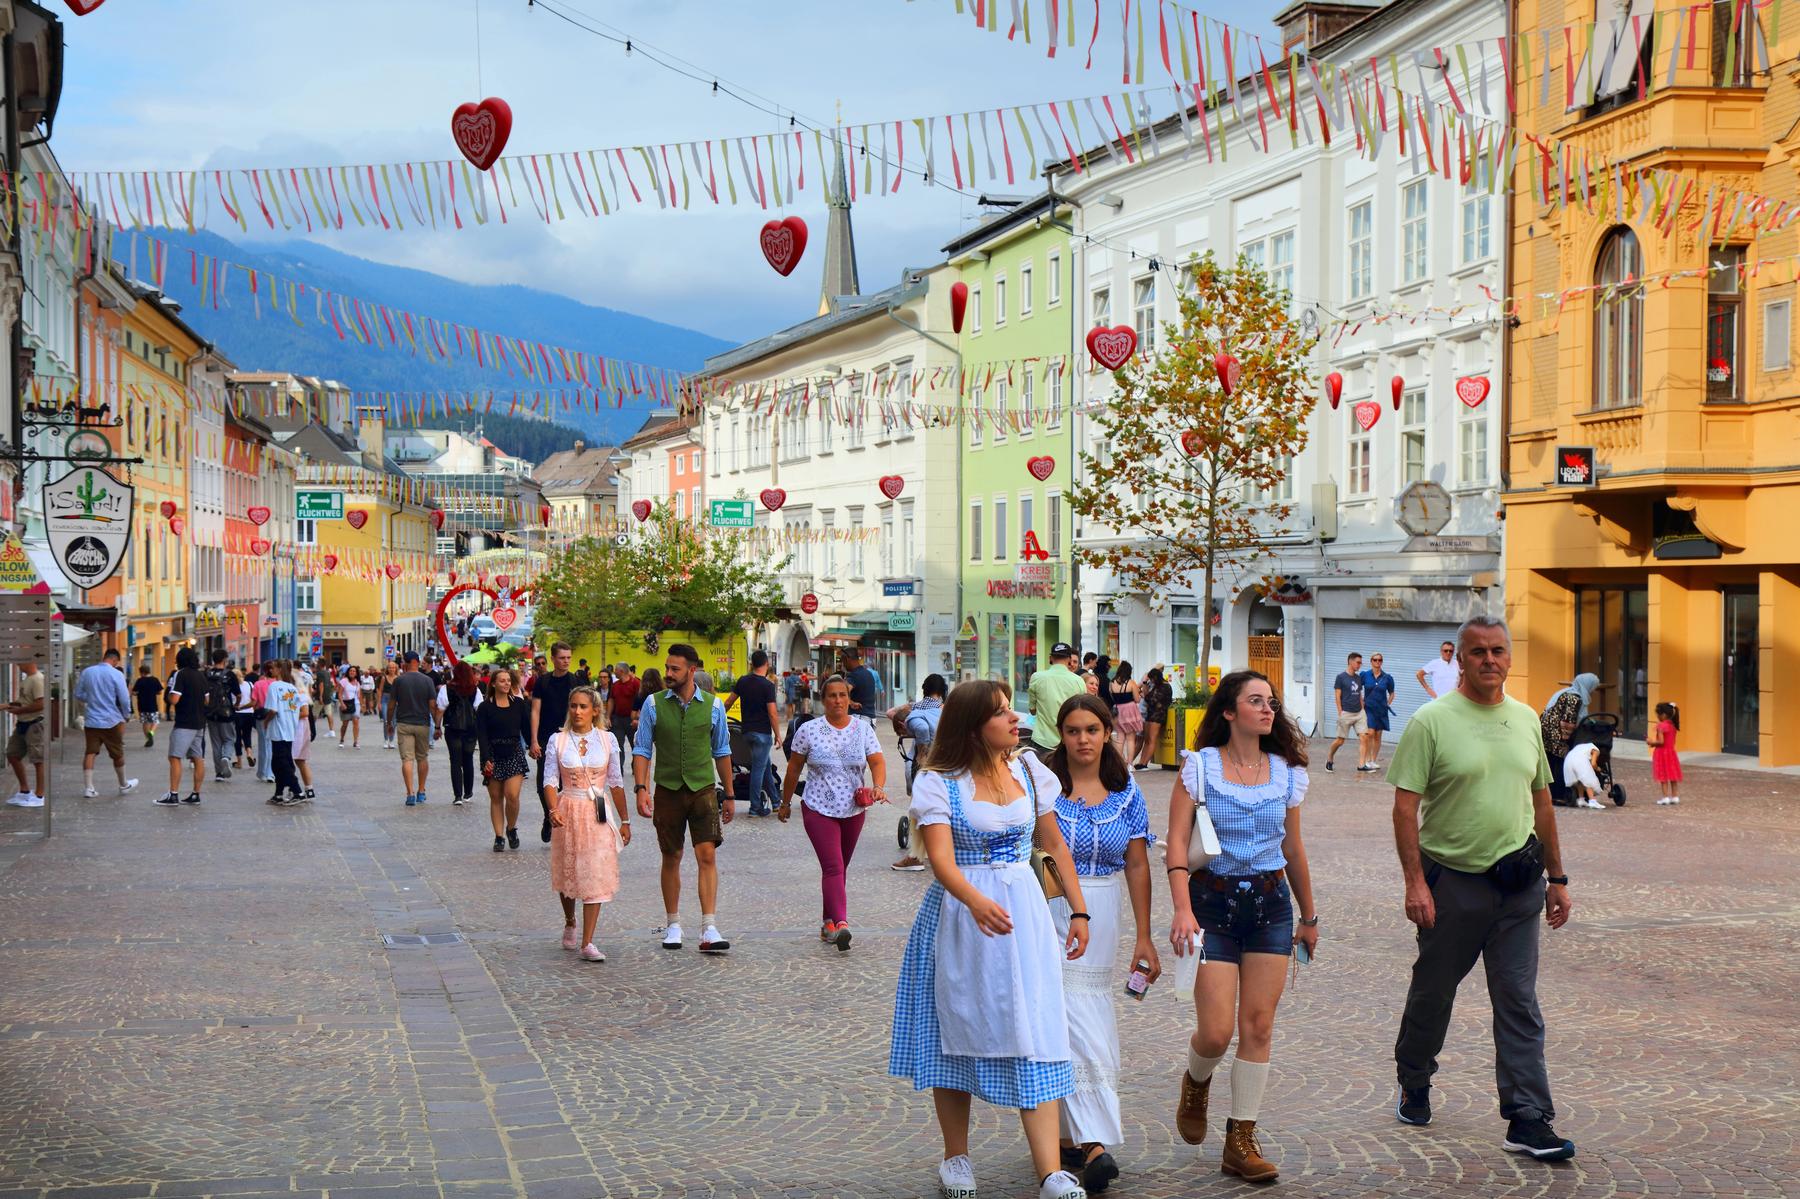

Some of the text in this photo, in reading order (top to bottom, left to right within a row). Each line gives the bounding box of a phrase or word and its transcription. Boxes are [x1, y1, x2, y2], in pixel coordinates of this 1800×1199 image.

[1563, 473, 1585, 482] hair
[298, 509, 342, 518] FLUCHTWEG
[713, 517, 752, 526] FLUCHTWEG
[0, 562, 30, 572] LOW
[1020, 566, 1051, 575] KREIS
[710, 648, 736, 656] villah
